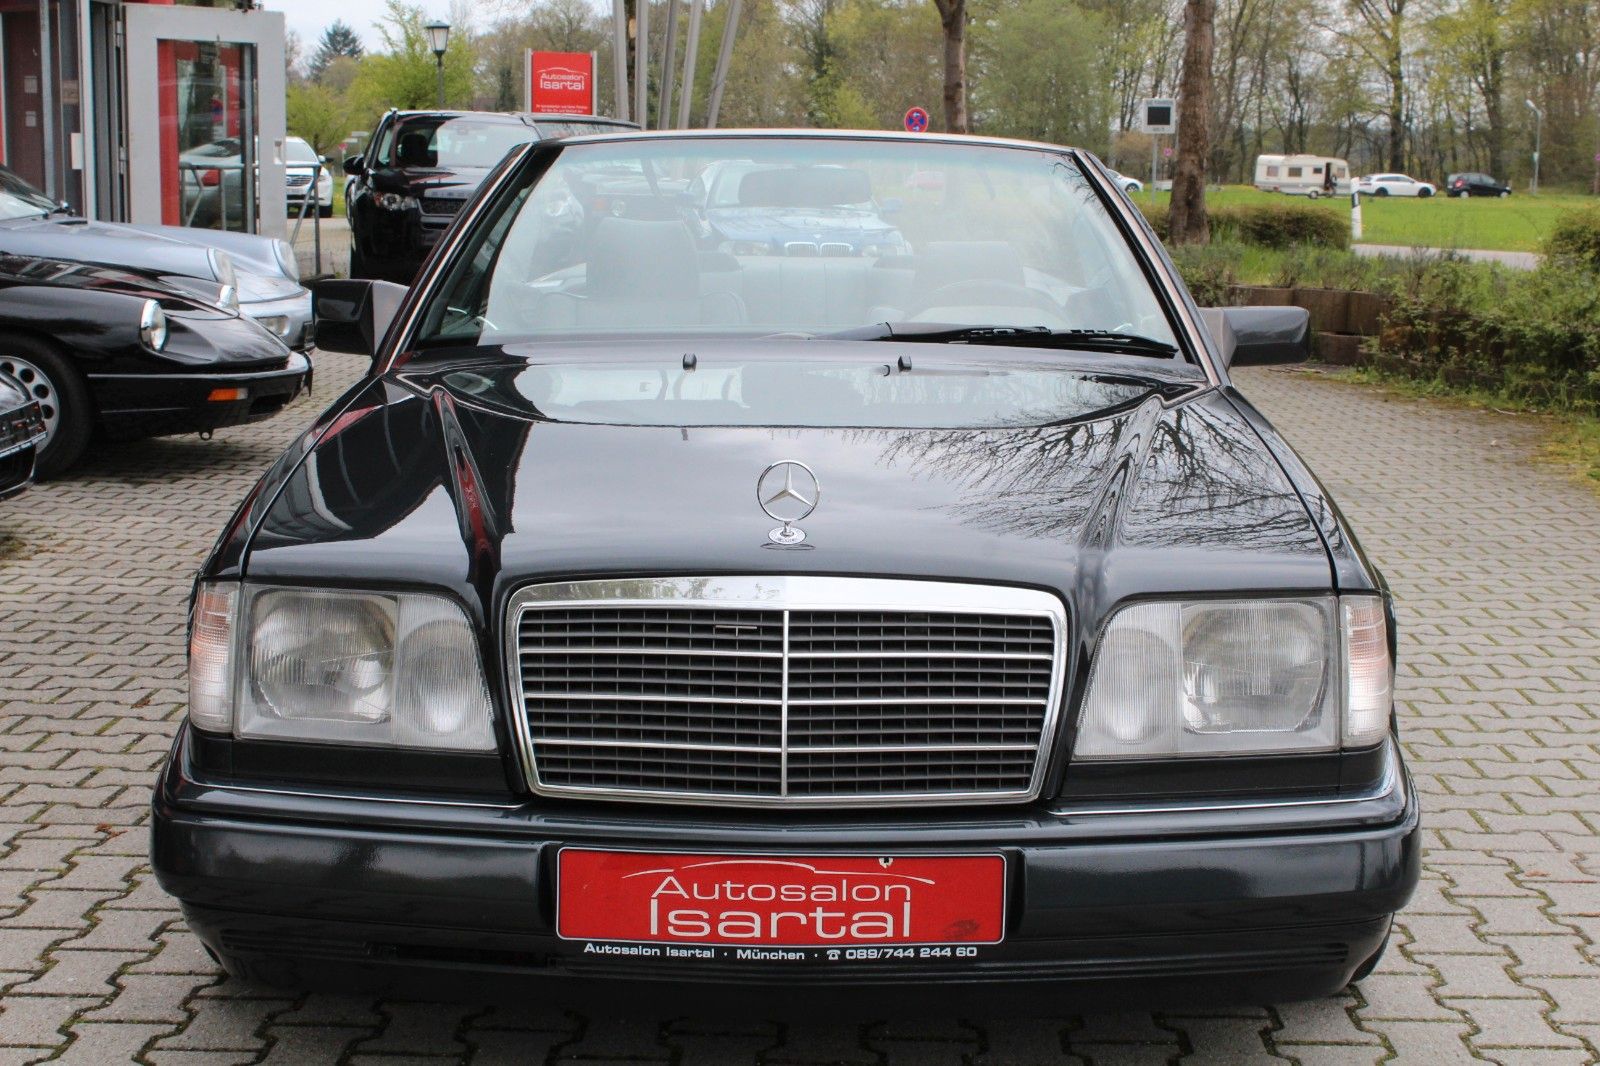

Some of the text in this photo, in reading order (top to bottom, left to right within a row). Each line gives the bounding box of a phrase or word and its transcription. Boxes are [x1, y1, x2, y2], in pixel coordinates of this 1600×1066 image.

[540, 79, 585, 91] Isartal
[651, 875, 912, 902] Autosalon
[650, 898, 911, 939] Isartal
[583, 943, 978, 960] Autosalon Isartal München 089/744 244 60
